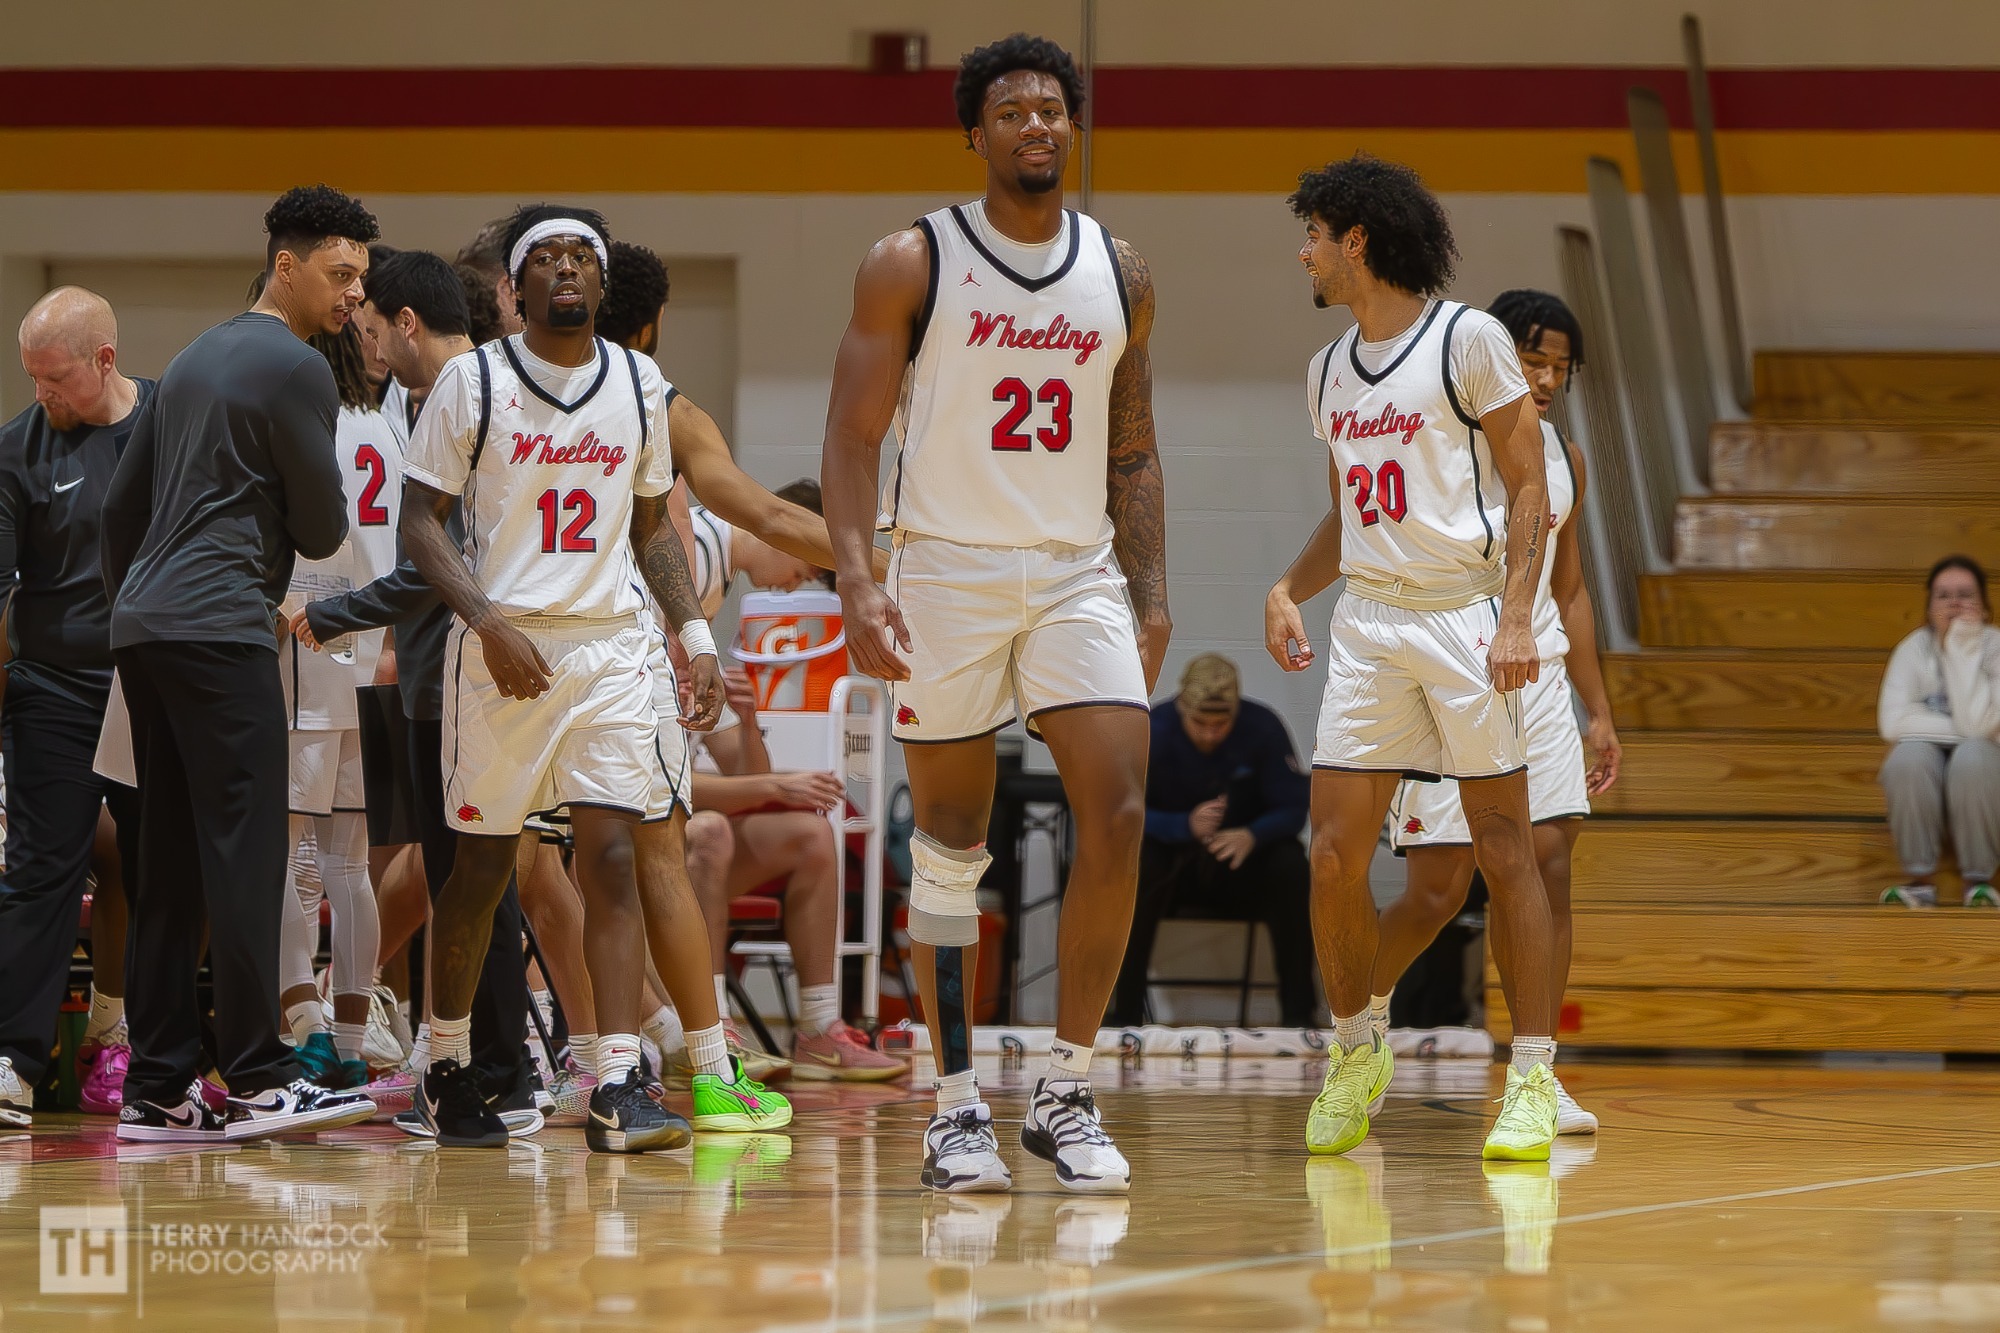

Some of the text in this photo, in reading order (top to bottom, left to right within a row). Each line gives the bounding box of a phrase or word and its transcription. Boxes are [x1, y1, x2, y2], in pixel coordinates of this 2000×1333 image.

[966, 310, 1103, 366] Wheeling
[991, 376, 1073, 453] 23
[1329, 401, 1425, 446] Wheeling
[354, 443, 390, 527] 2
[508, 430, 627, 477] Wheeling
[536, 488, 597, 554] 12
[1346, 459, 1408, 528] 20
